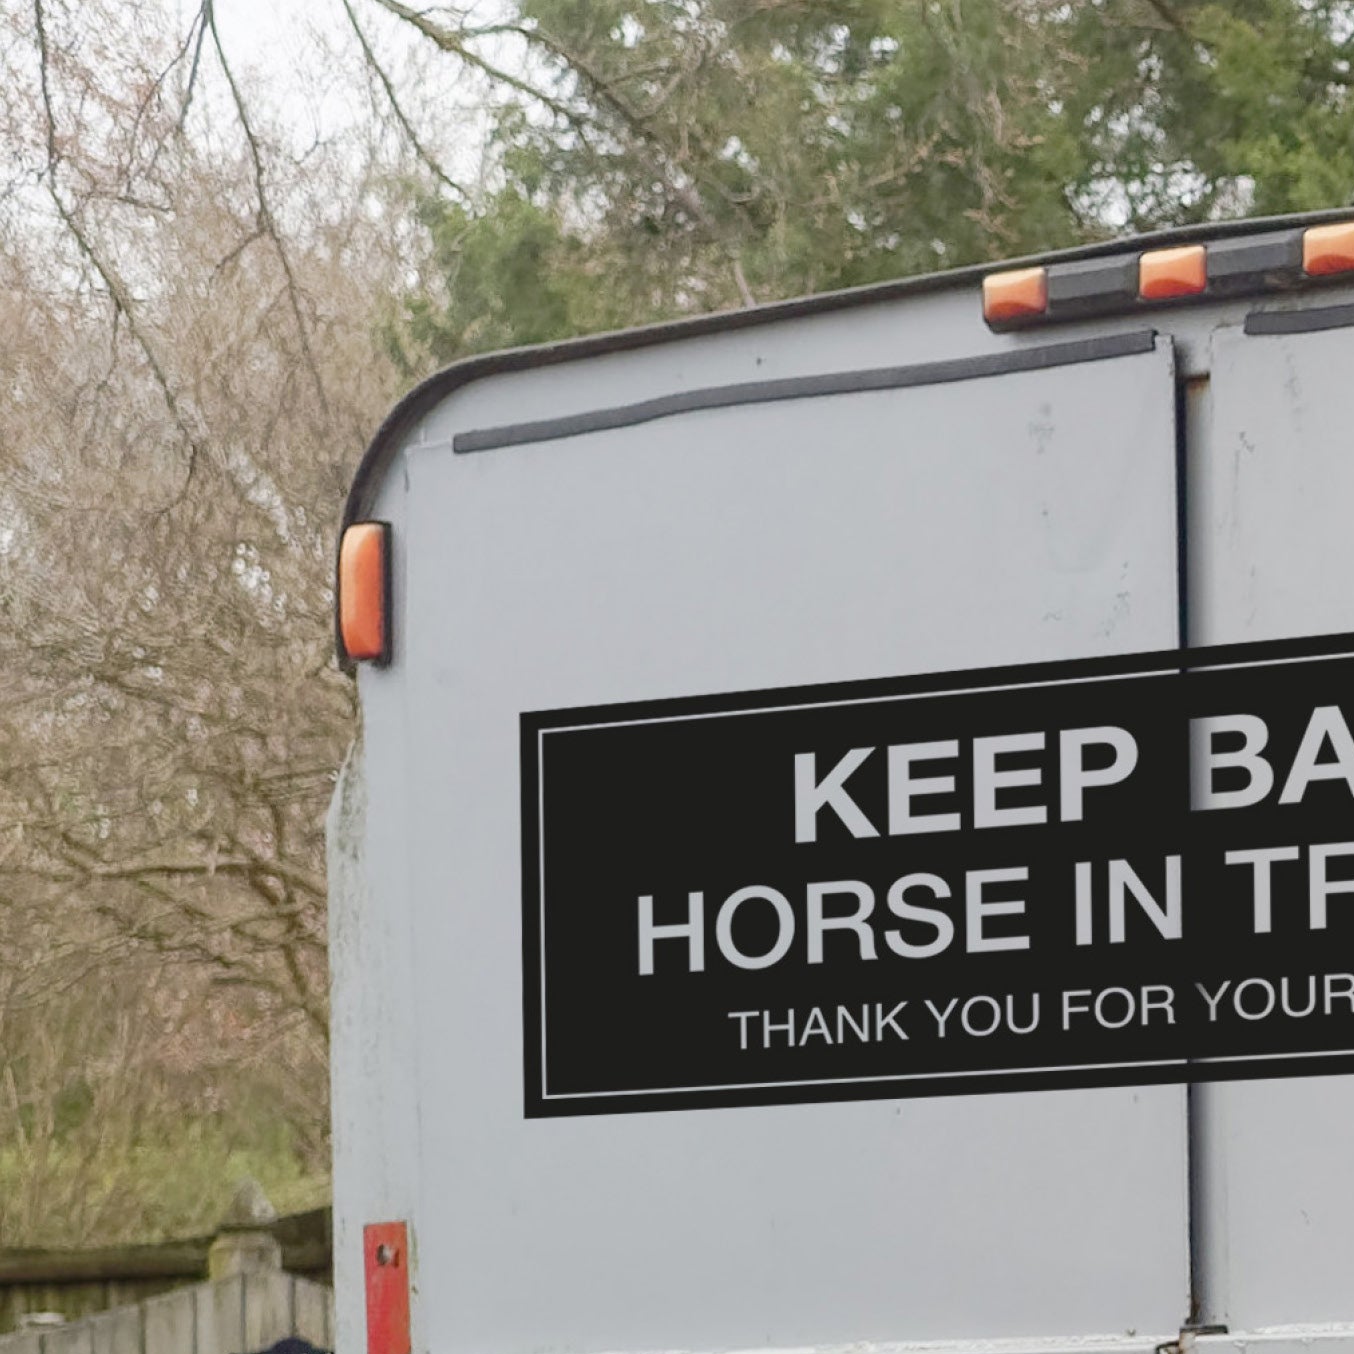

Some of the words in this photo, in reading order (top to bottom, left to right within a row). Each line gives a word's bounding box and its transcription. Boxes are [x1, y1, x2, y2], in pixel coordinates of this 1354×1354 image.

[794, 726, 1139, 843] KEEP
[638, 866, 1031, 977] HORSE
[1075, 854, 1183, 946] IN
[727, 1000, 909, 1050] THANK
[924, 992, 1041, 1037] YOU
[1062, 985, 1176, 1031] FOR
